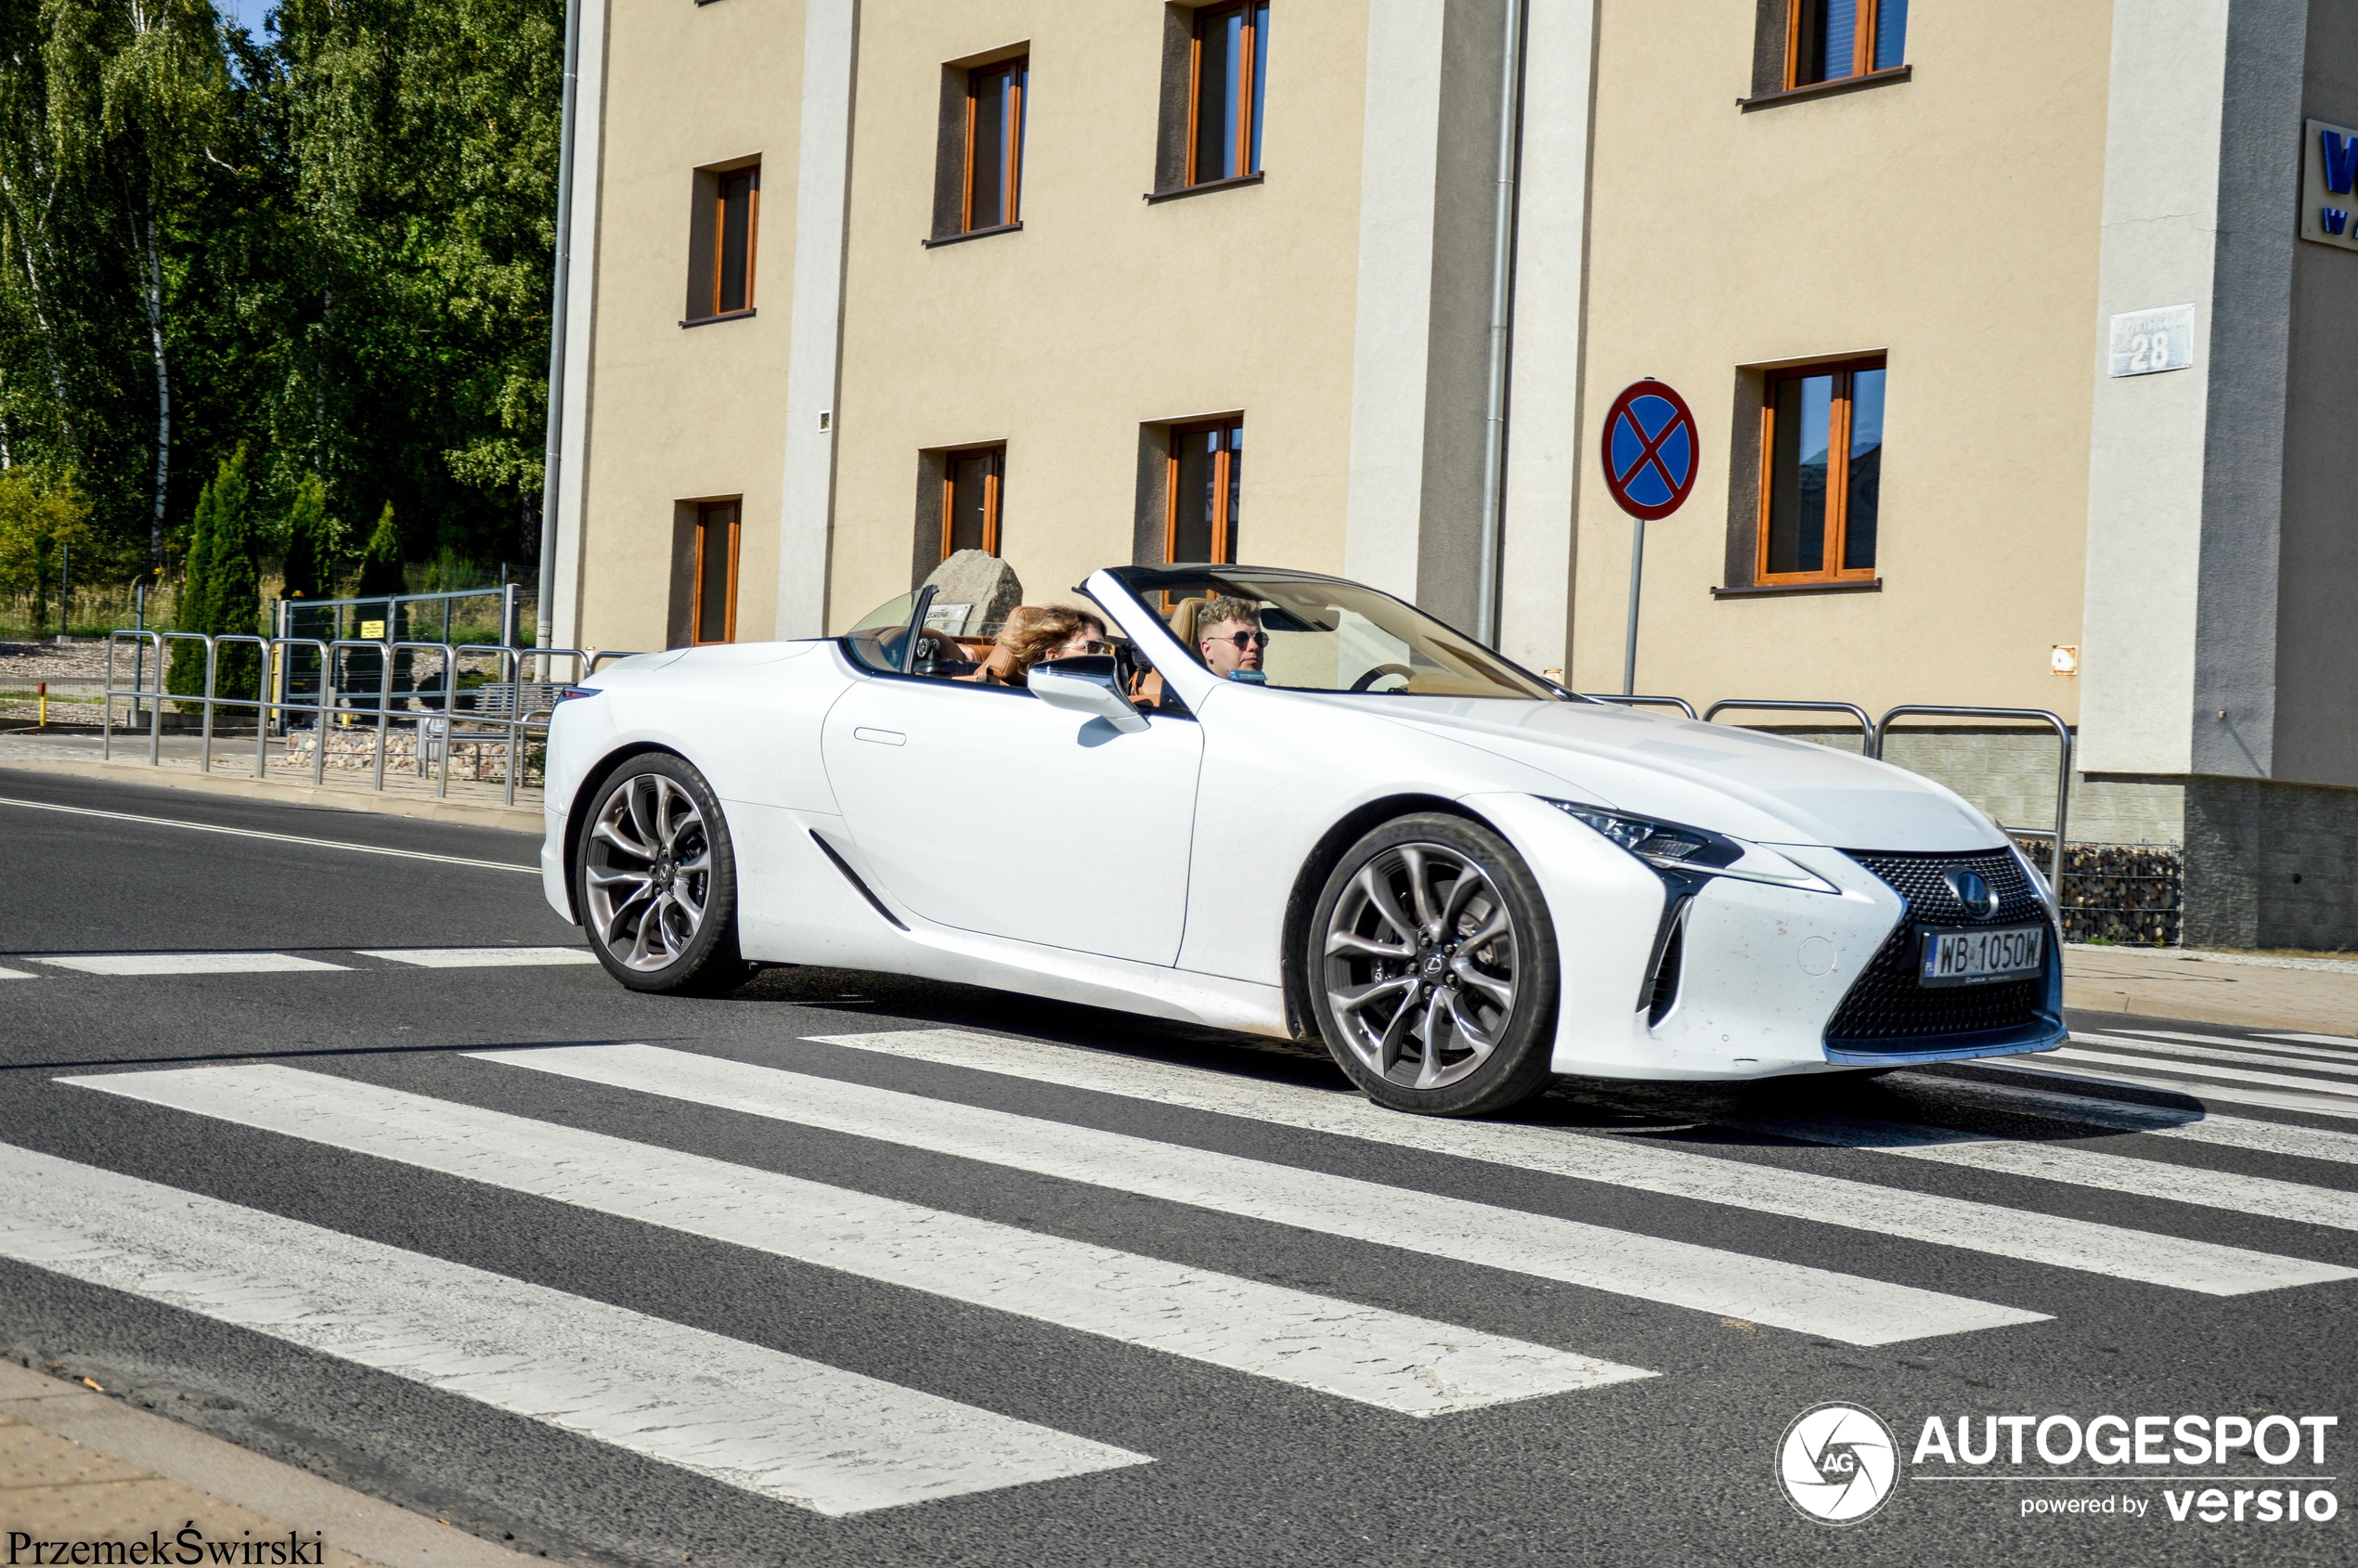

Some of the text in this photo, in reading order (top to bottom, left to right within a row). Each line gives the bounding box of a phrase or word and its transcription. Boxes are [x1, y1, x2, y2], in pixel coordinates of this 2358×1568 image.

[2130, 331, 2170, 370] 28
[1940, 931, 2039, 974] WB 1050W
[1365, 1078, 1419, 1107] MICHELIN
